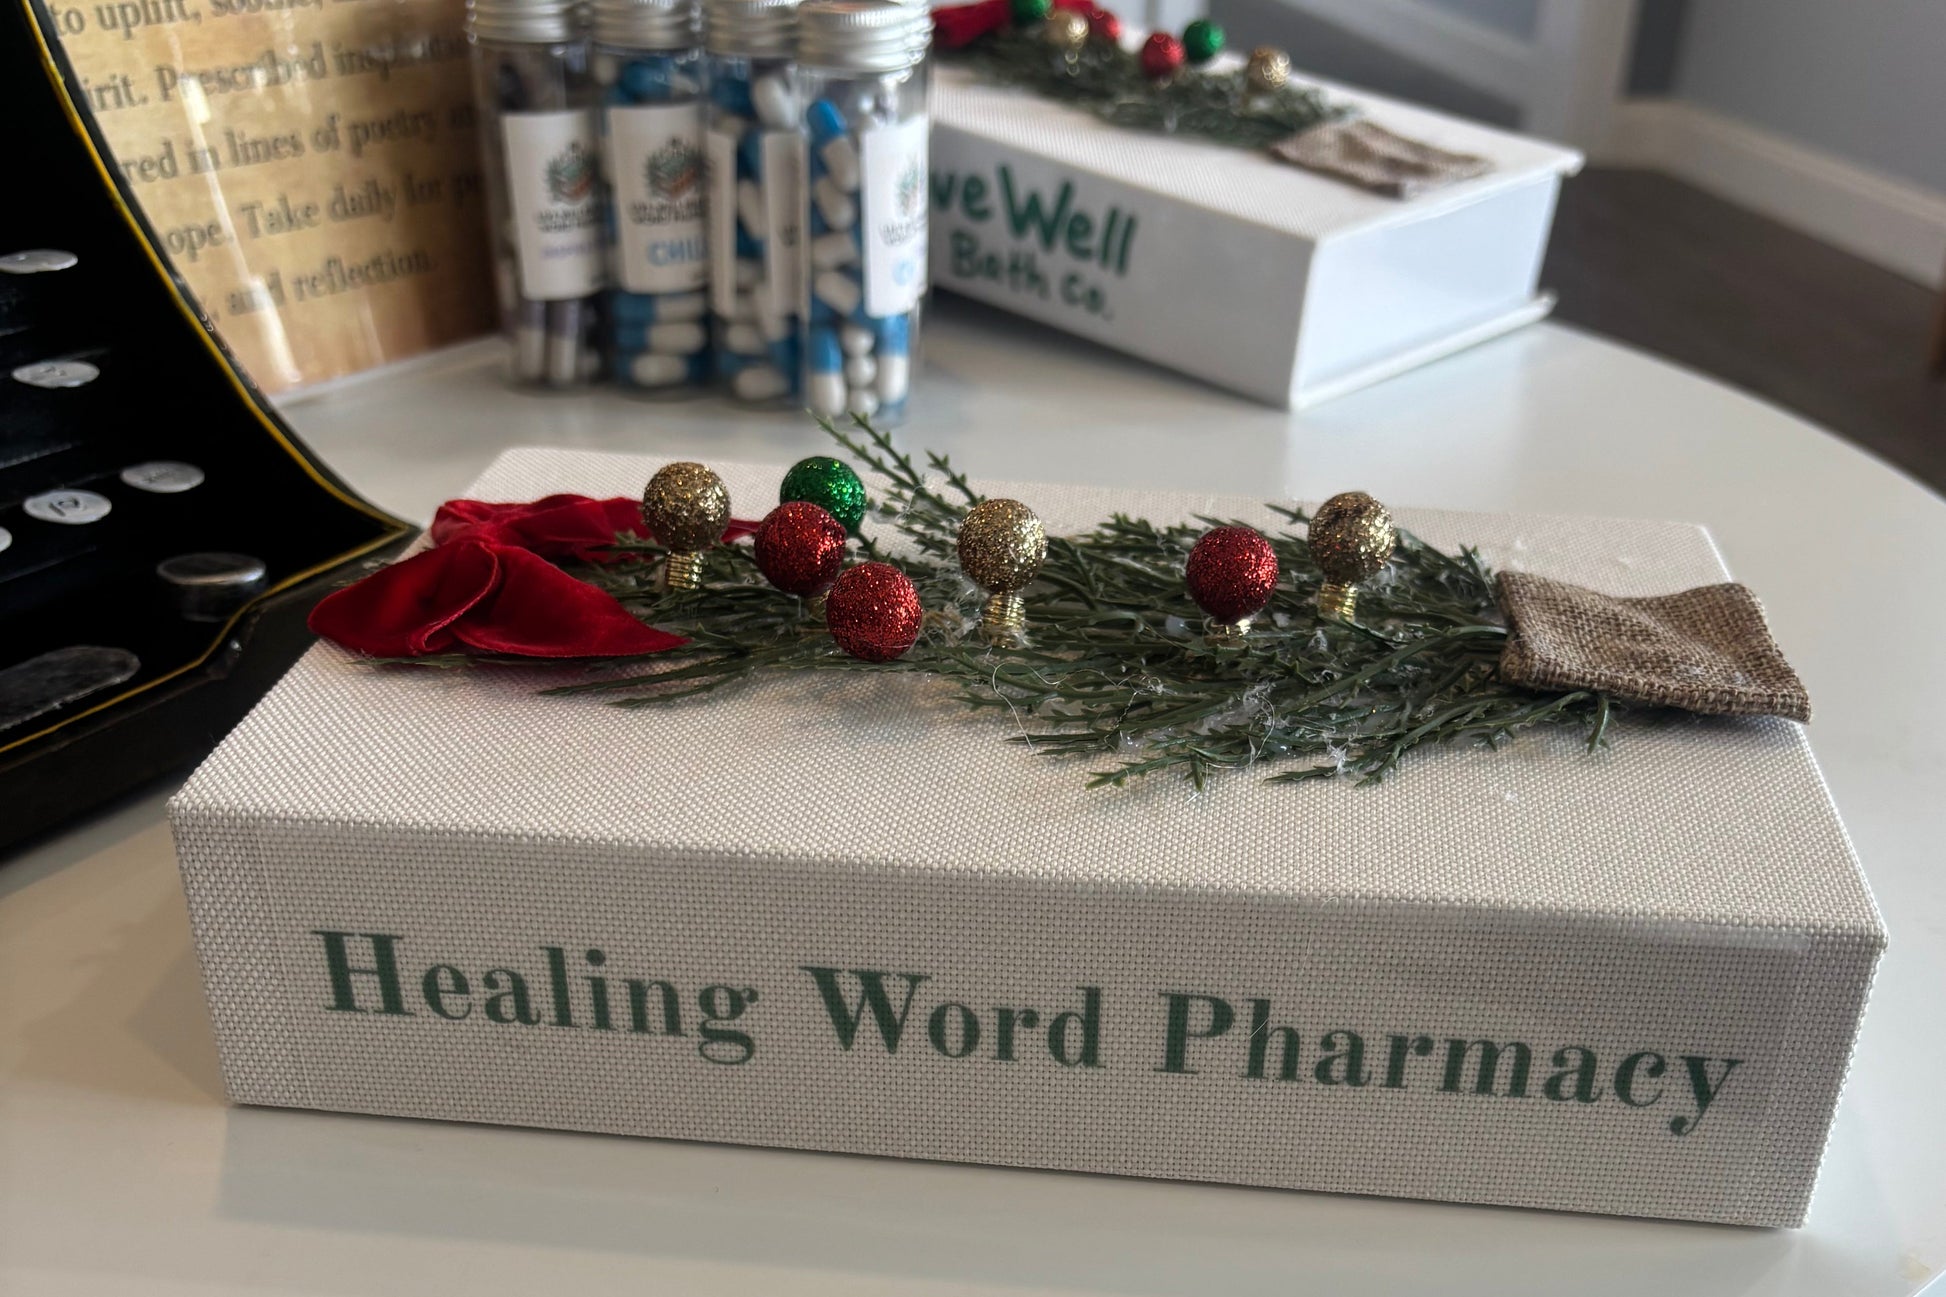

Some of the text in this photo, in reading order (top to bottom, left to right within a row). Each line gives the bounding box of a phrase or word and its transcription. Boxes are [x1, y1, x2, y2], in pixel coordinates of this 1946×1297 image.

[50, 7, 86, 38] to
[96, 0, 203, 40] uplift,
[157, 42, 327, 103] Prescribed
[122, 141, 180, 187] red
[188, 146, 220, 176] in
[228, 128, 303, 173] lines
[313, 113, 342, 155] of
[240, 192, 322, 241] Take
[328, 174, 398, 223] daily
[947, 227, 1050, 300] Bath
[311, 929, 1746, 1138] Healing Word Pharmacy
